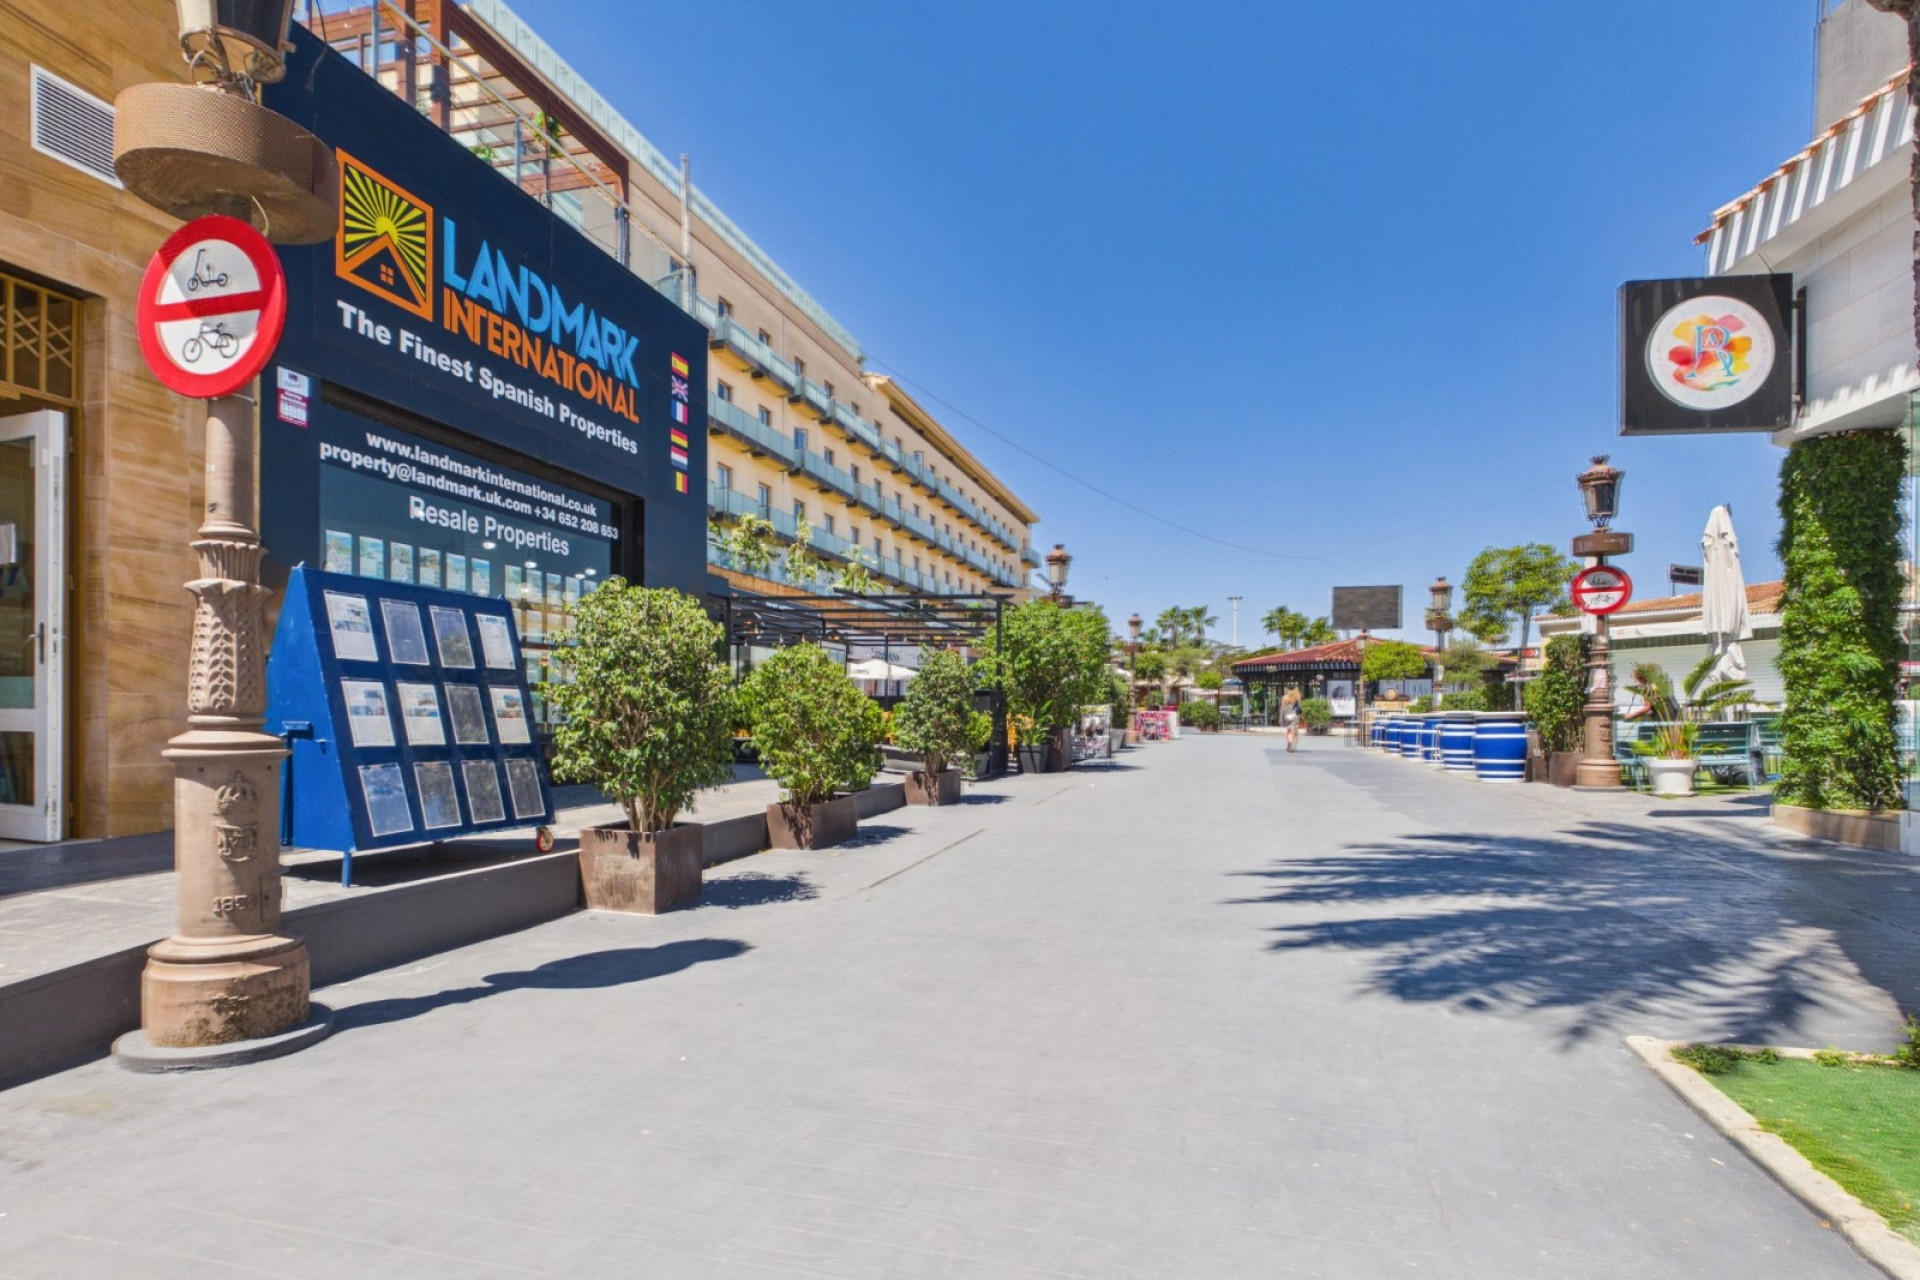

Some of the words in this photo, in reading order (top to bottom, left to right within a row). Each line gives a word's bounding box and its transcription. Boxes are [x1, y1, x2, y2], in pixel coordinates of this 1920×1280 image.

[443, 216, 639, 389] LANDMARK
[443, 286, 640, 424] INTERNATIONAL
[336, 299, 392, 346] The
[399, 328, 474, 383] Finest
[479, 366, 555, 418] Spanish
[558, 402, 638, 455] Properties
[319, 441, 532, 515] property@landmark.uk.com
[533, 505, 556, 522] +34
[558, 511, 578, 529] 652
[580, 518, 599, 534] 208
[600, 524, 619, 540] 653
[365, 431, 597, 517] www.landmarkinternational.co.uk
[409, 495, 480, 535] Resale
[484, 515, 570, 556] Properties
